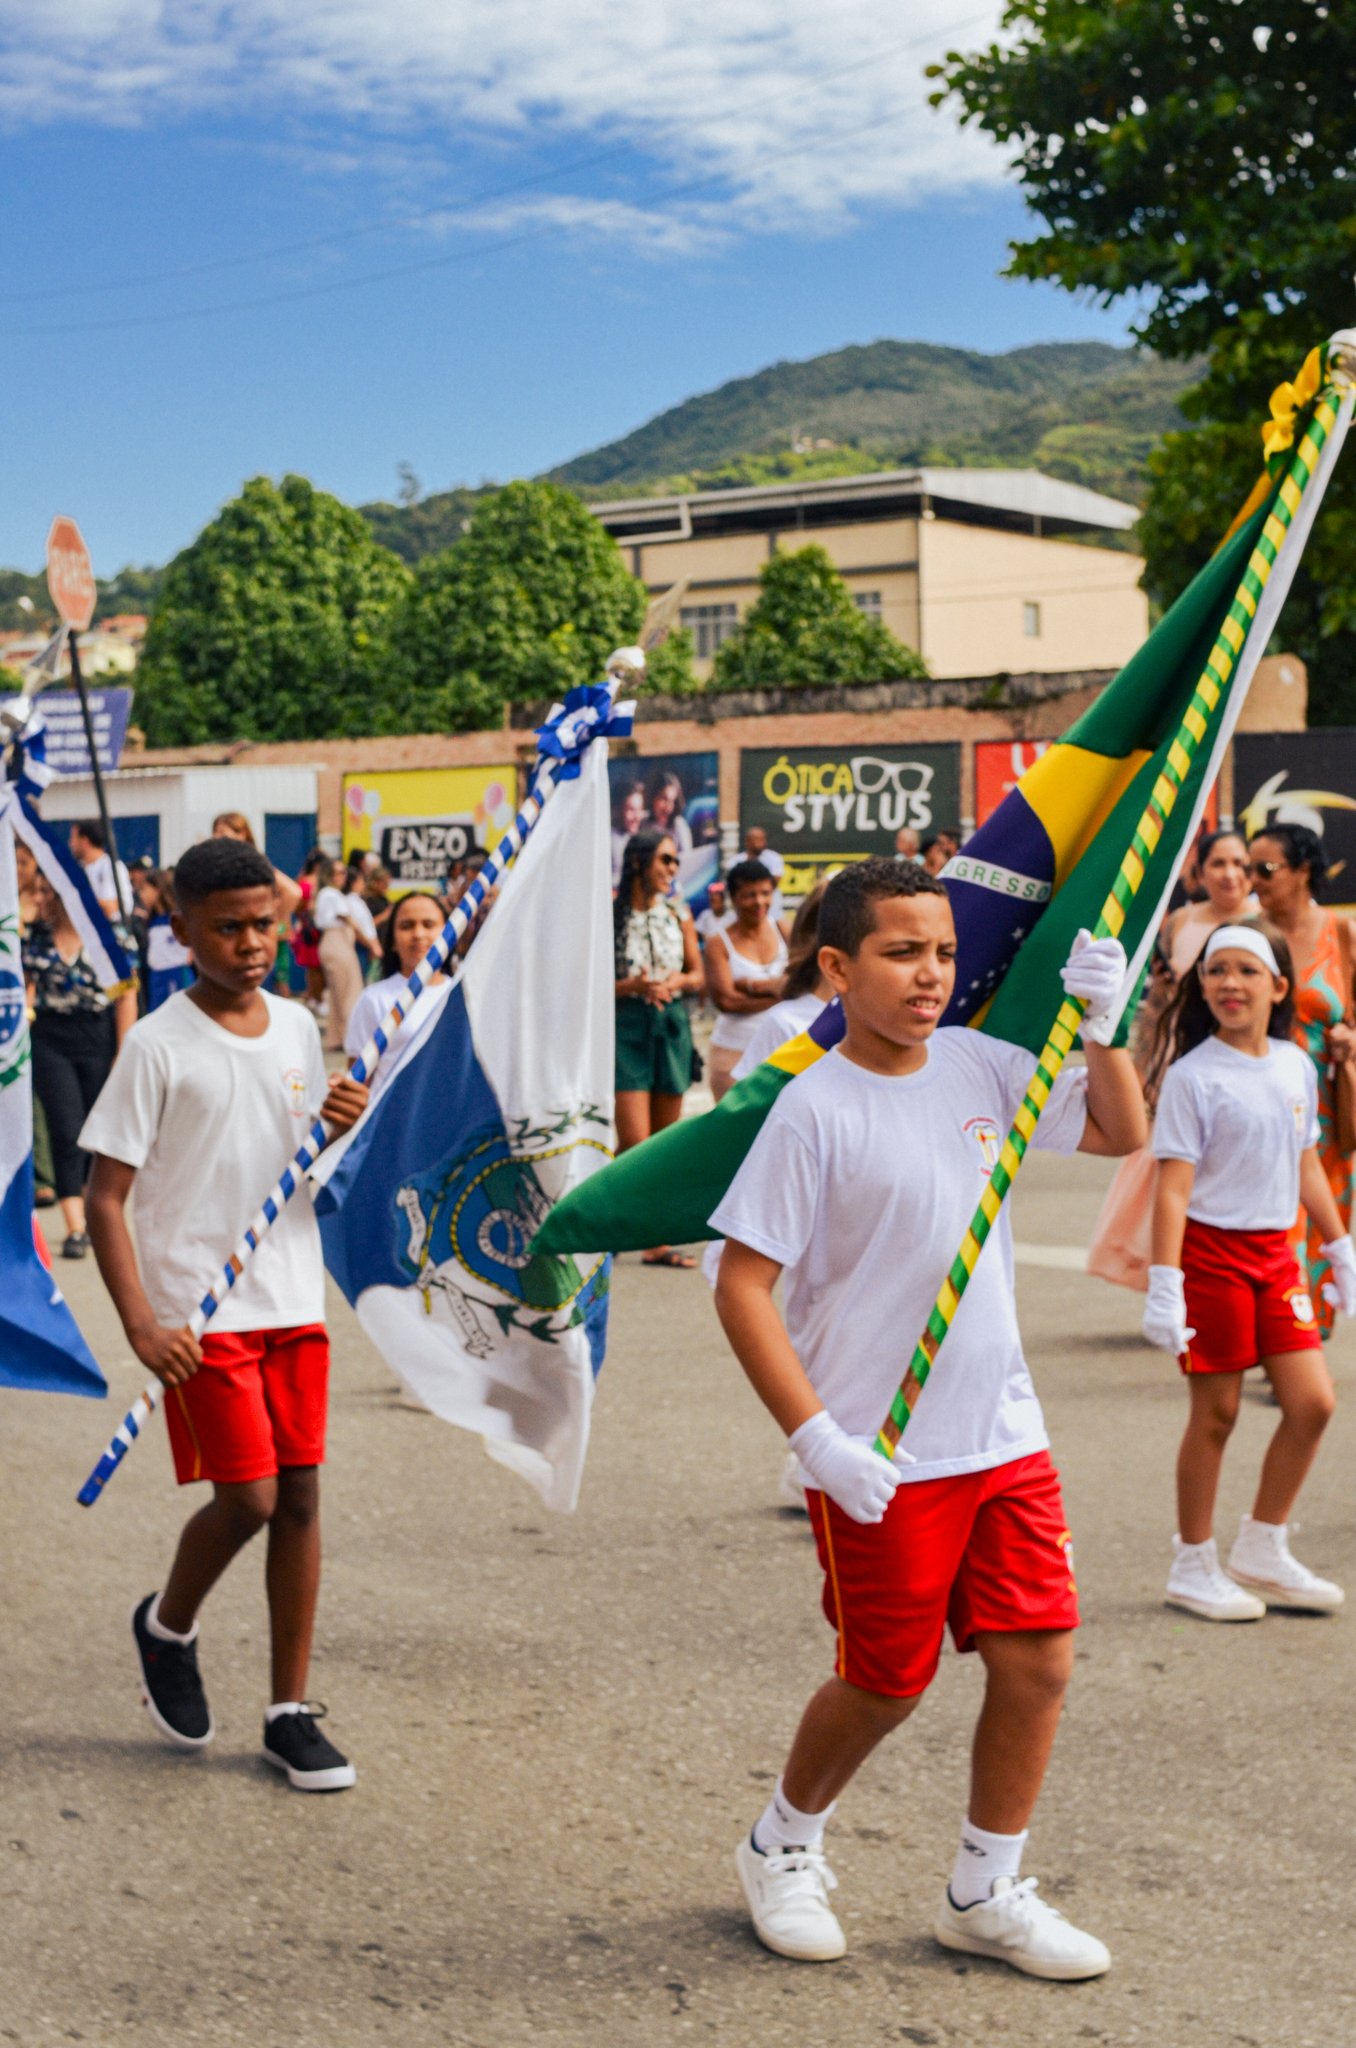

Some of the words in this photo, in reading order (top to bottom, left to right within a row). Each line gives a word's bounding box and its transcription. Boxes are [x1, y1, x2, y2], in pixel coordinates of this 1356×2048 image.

[763, 755, 854, 804] ÓTICA
[783, 791, 932, 833] STYLUS
[390, 826, 467, 861] ENZO
